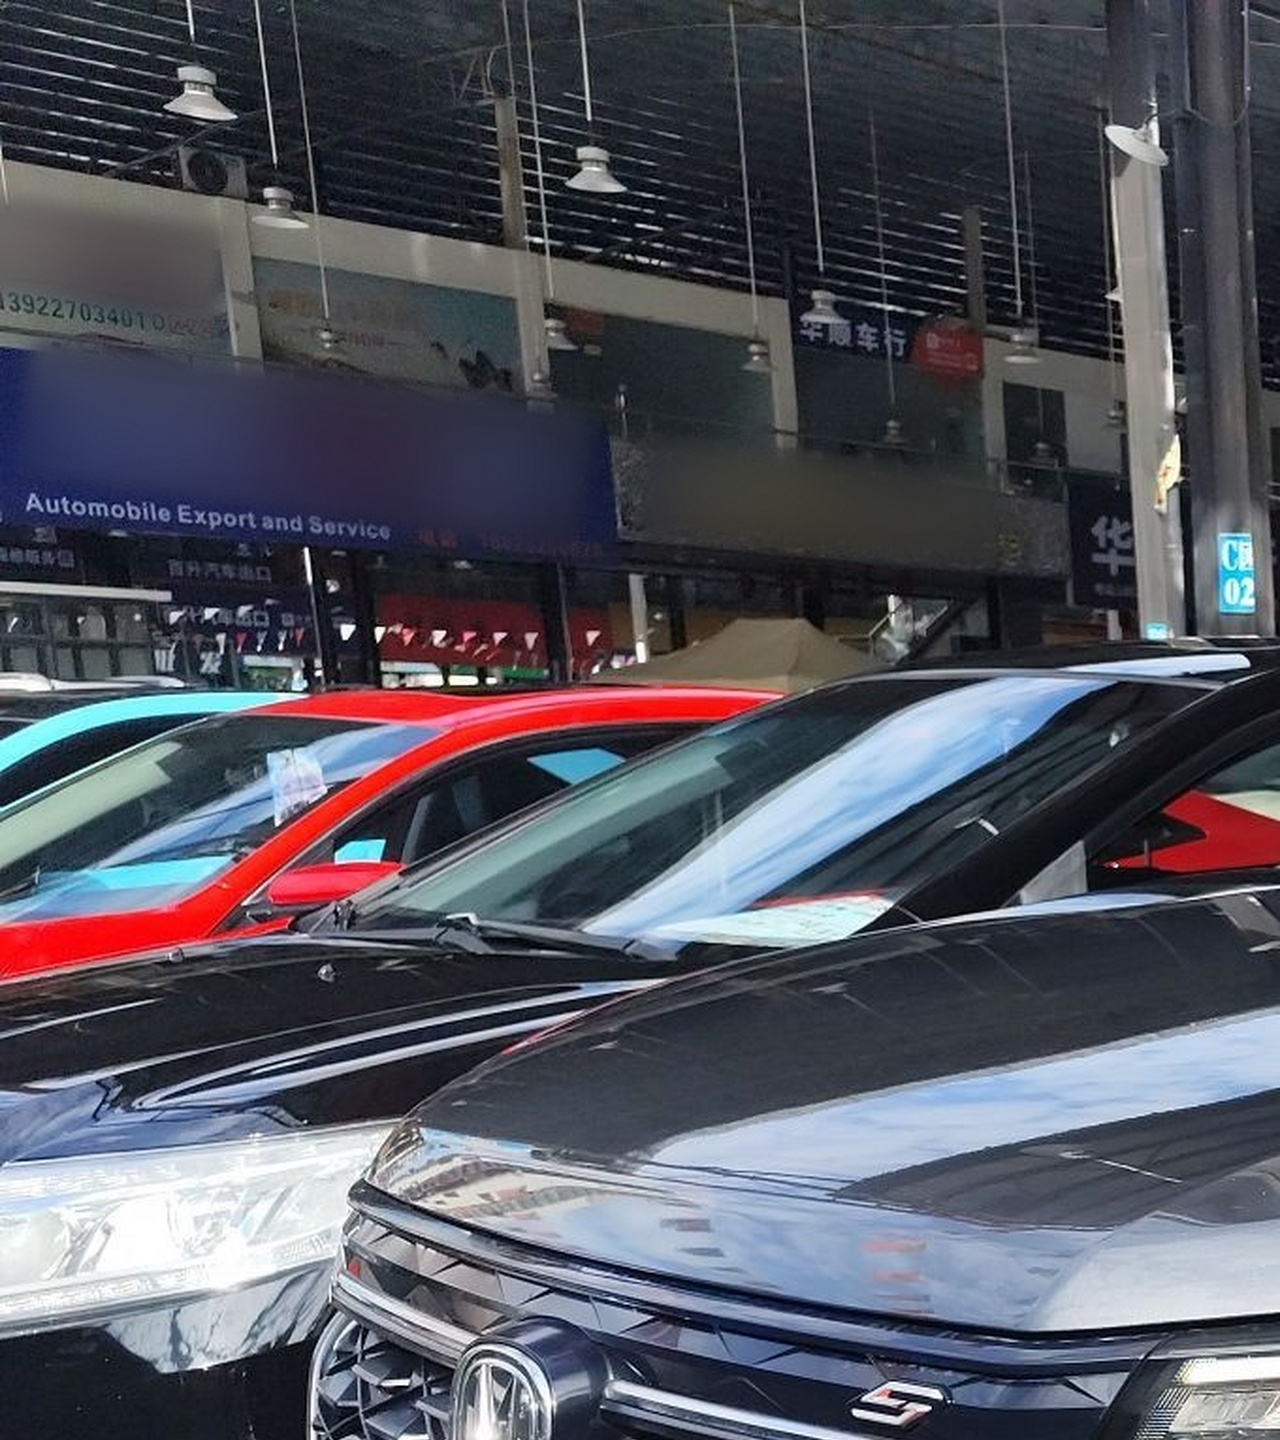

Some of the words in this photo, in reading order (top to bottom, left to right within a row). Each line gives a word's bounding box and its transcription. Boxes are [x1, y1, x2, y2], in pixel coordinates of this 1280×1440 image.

[26, 492, 171, 523] Automobile
[177, 504, 257, 530] Export
[262, 512, 303, 533] and
[308, 515, 391, 540] Service
[1223, 577, 1256, 606] 02
